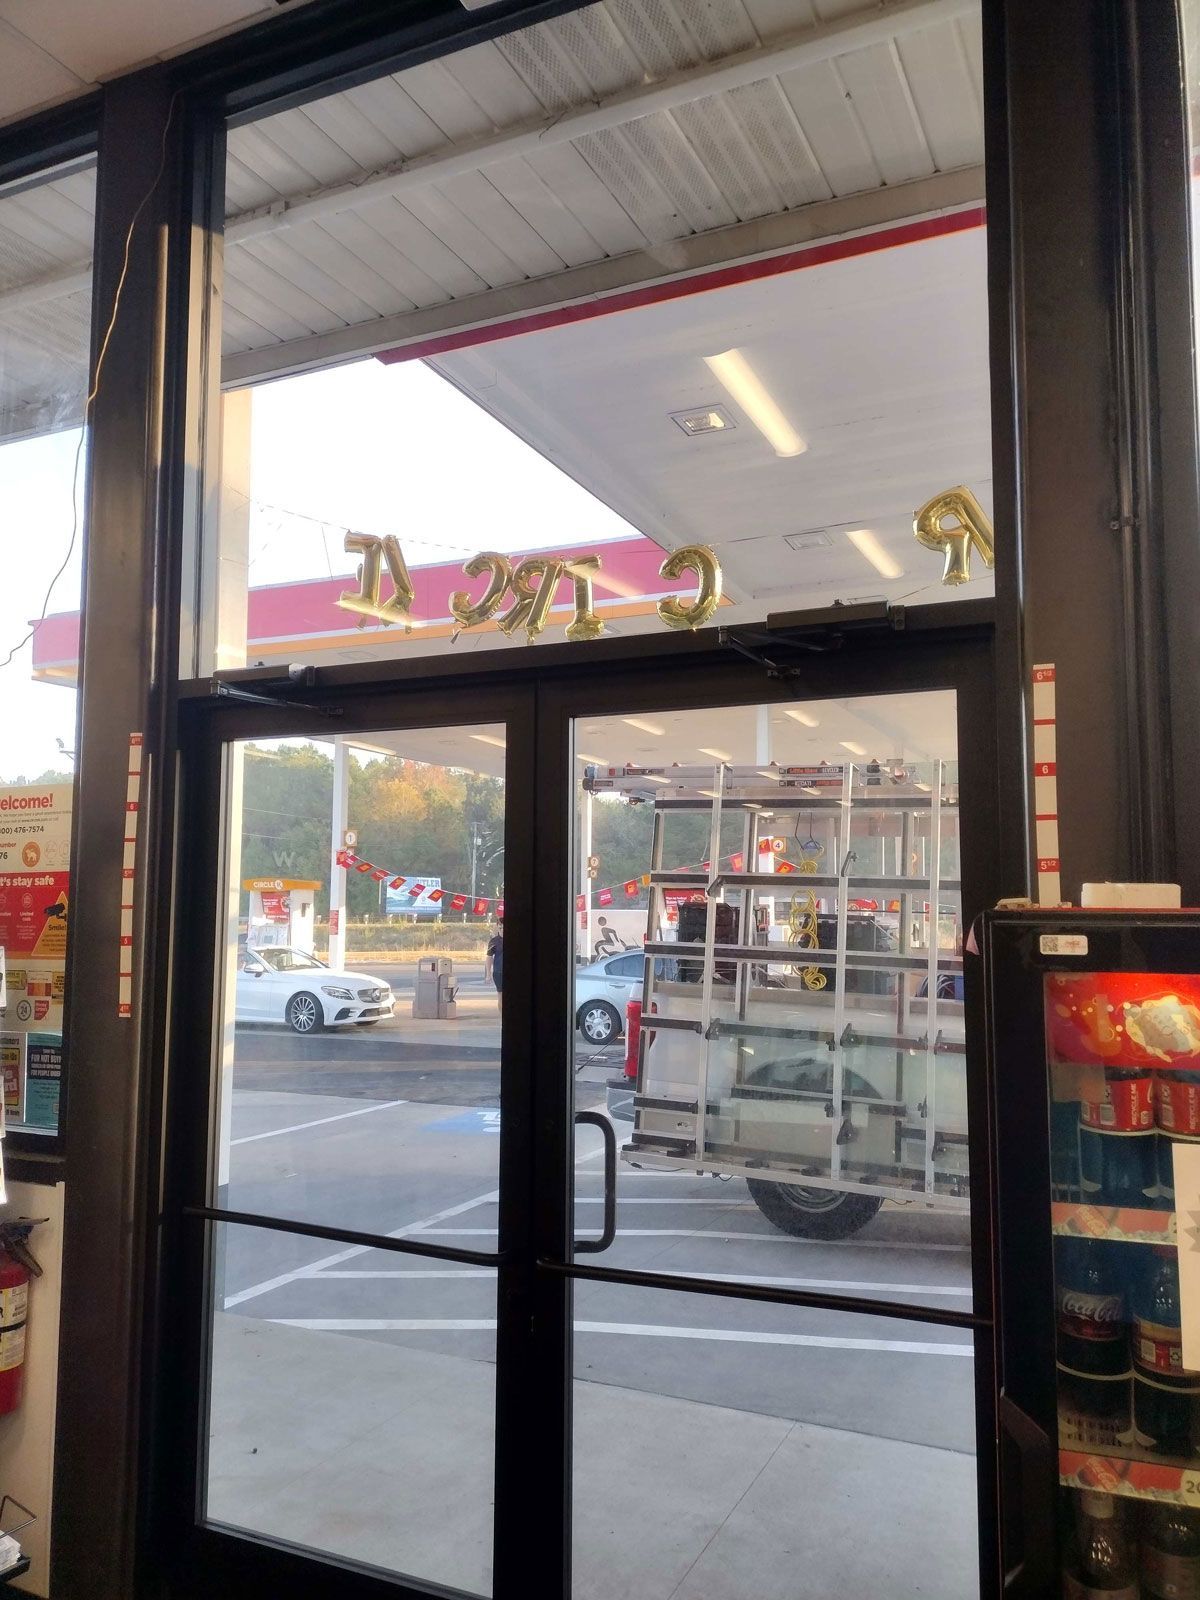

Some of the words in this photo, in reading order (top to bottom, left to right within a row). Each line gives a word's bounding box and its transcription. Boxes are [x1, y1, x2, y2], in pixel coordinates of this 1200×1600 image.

[1041, 765, 1049, 774] 6
[0, 793, 54, 810] elcome!
[14, 826, 45, 834] 476-7574
[12, 877, 33, 888] stay
[34, 875, 55, 886] safe
[1062, 1294, 1121, 1322] Coca-Col
